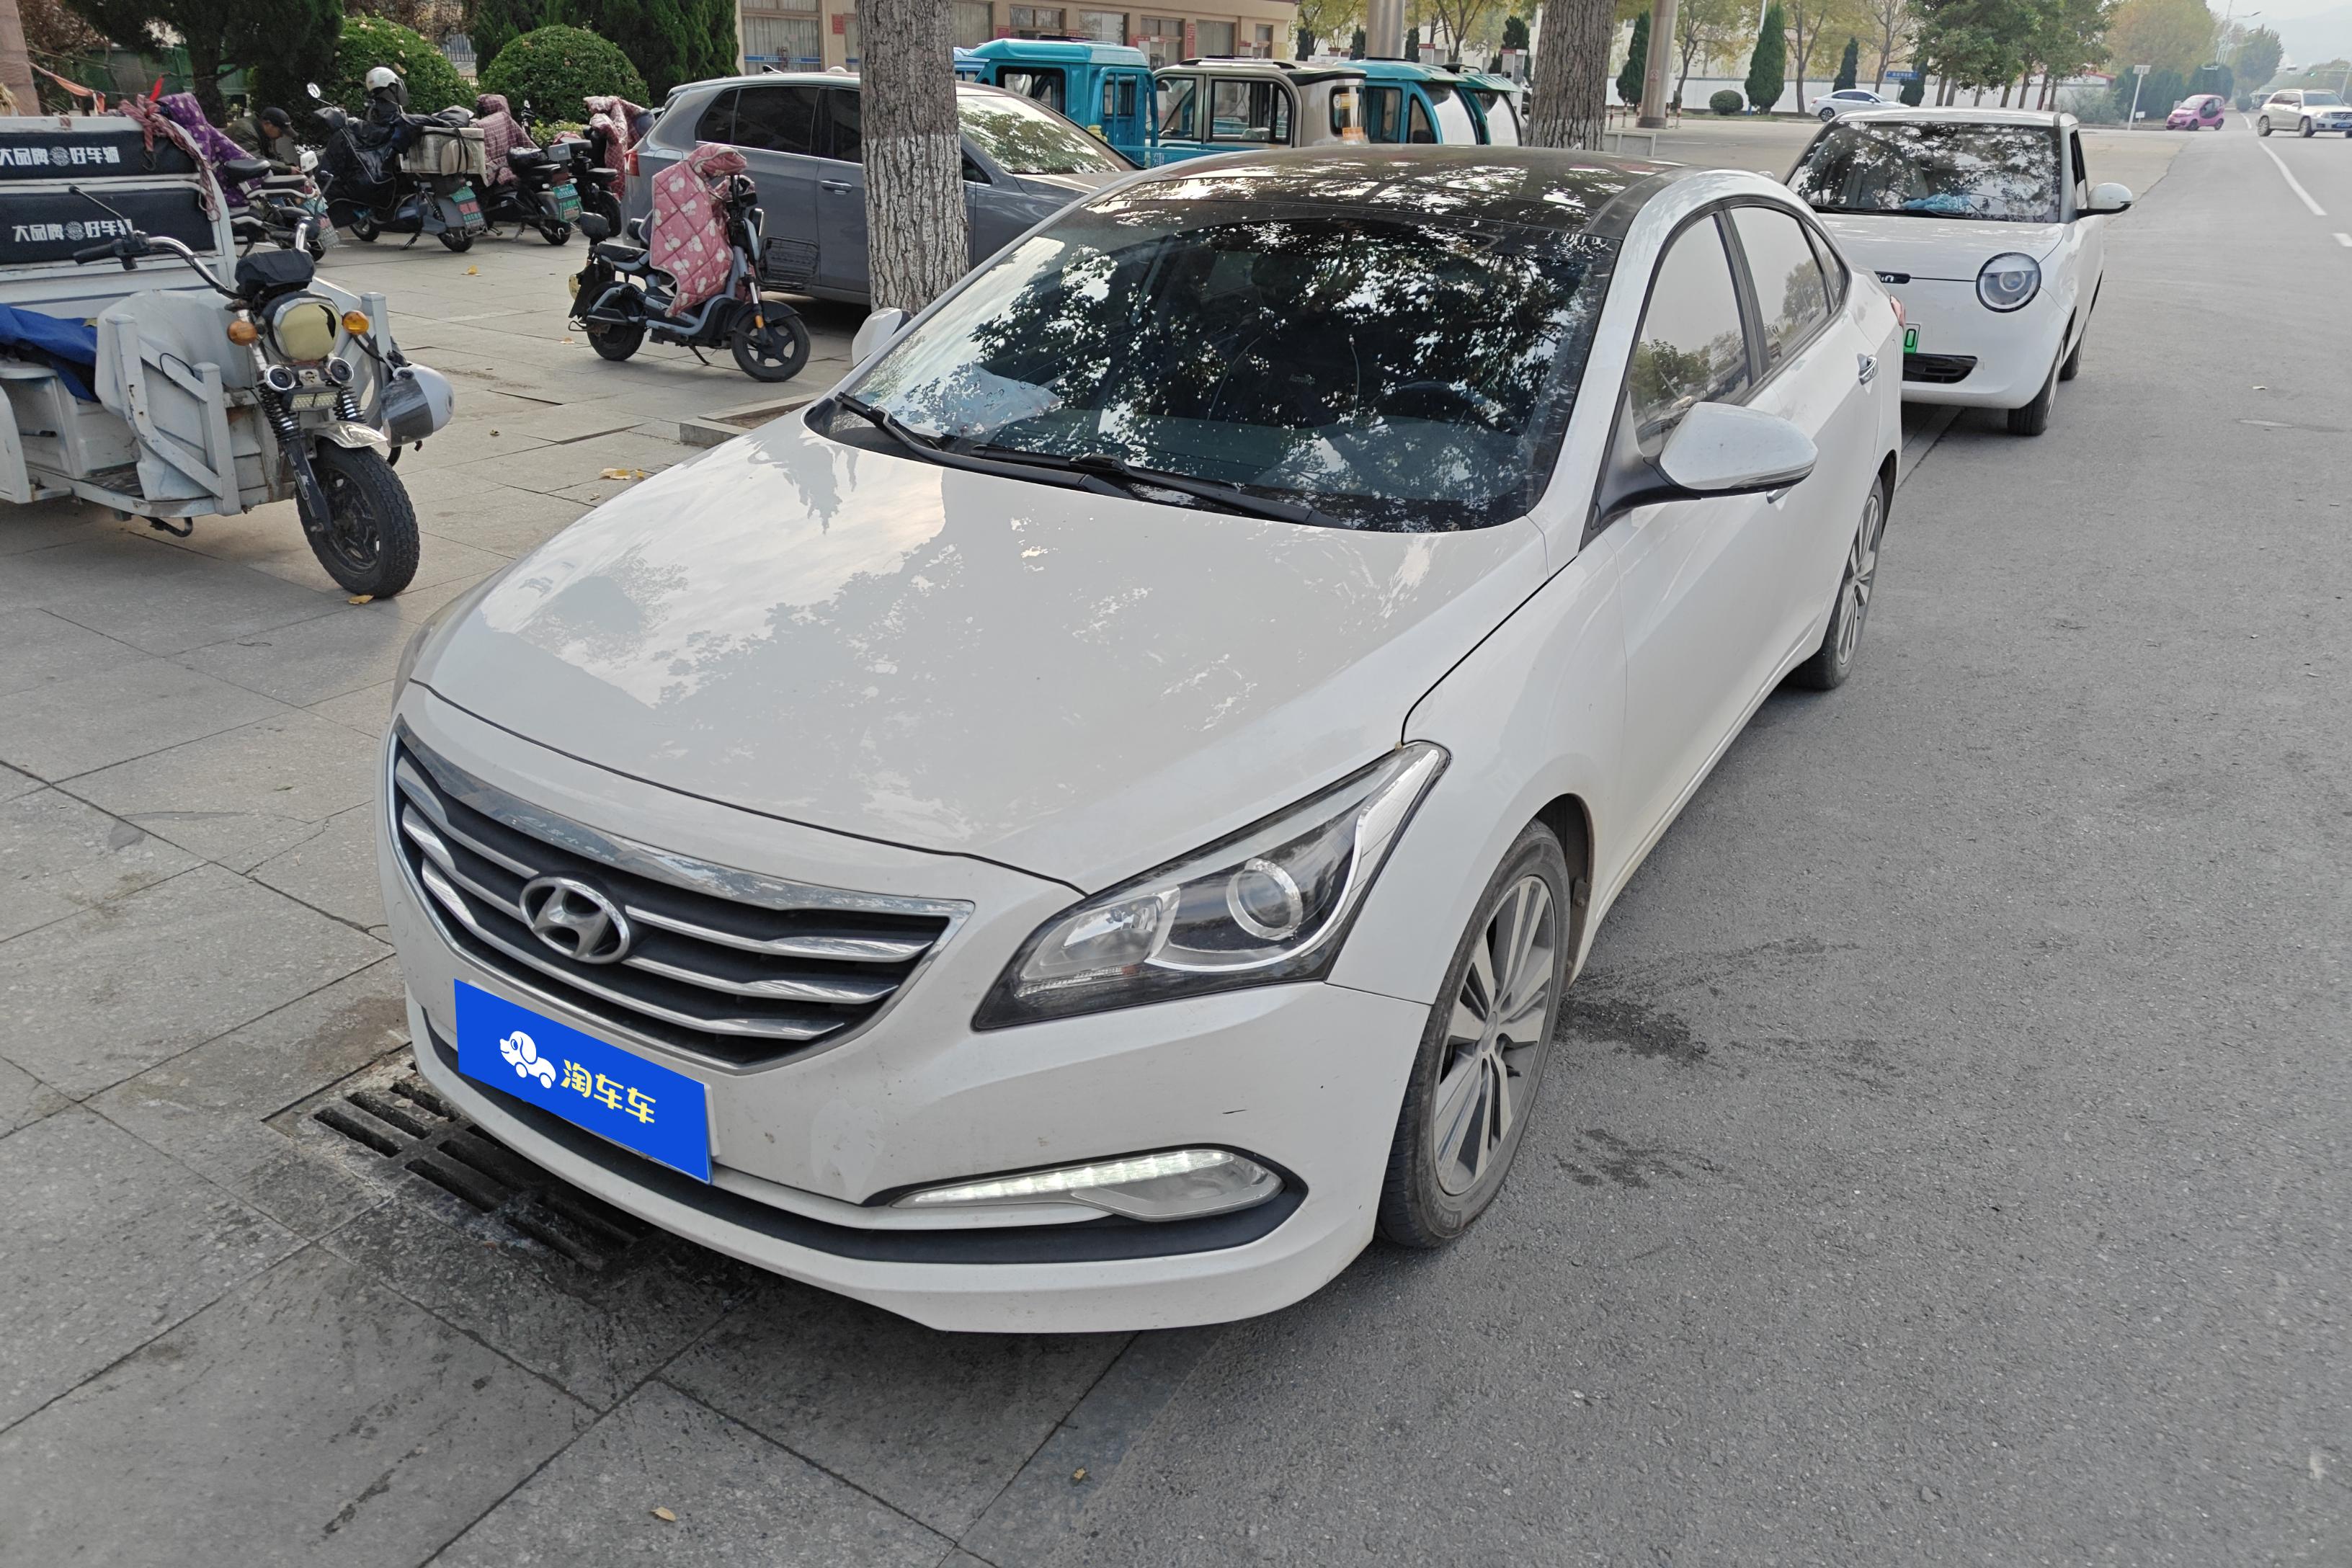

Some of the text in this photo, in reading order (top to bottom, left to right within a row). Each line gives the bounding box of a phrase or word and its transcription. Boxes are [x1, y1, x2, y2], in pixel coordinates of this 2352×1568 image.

[0, 146, 120, 166] 大品牌 好车辆
[12, 223, 66, 243] 大品牌
